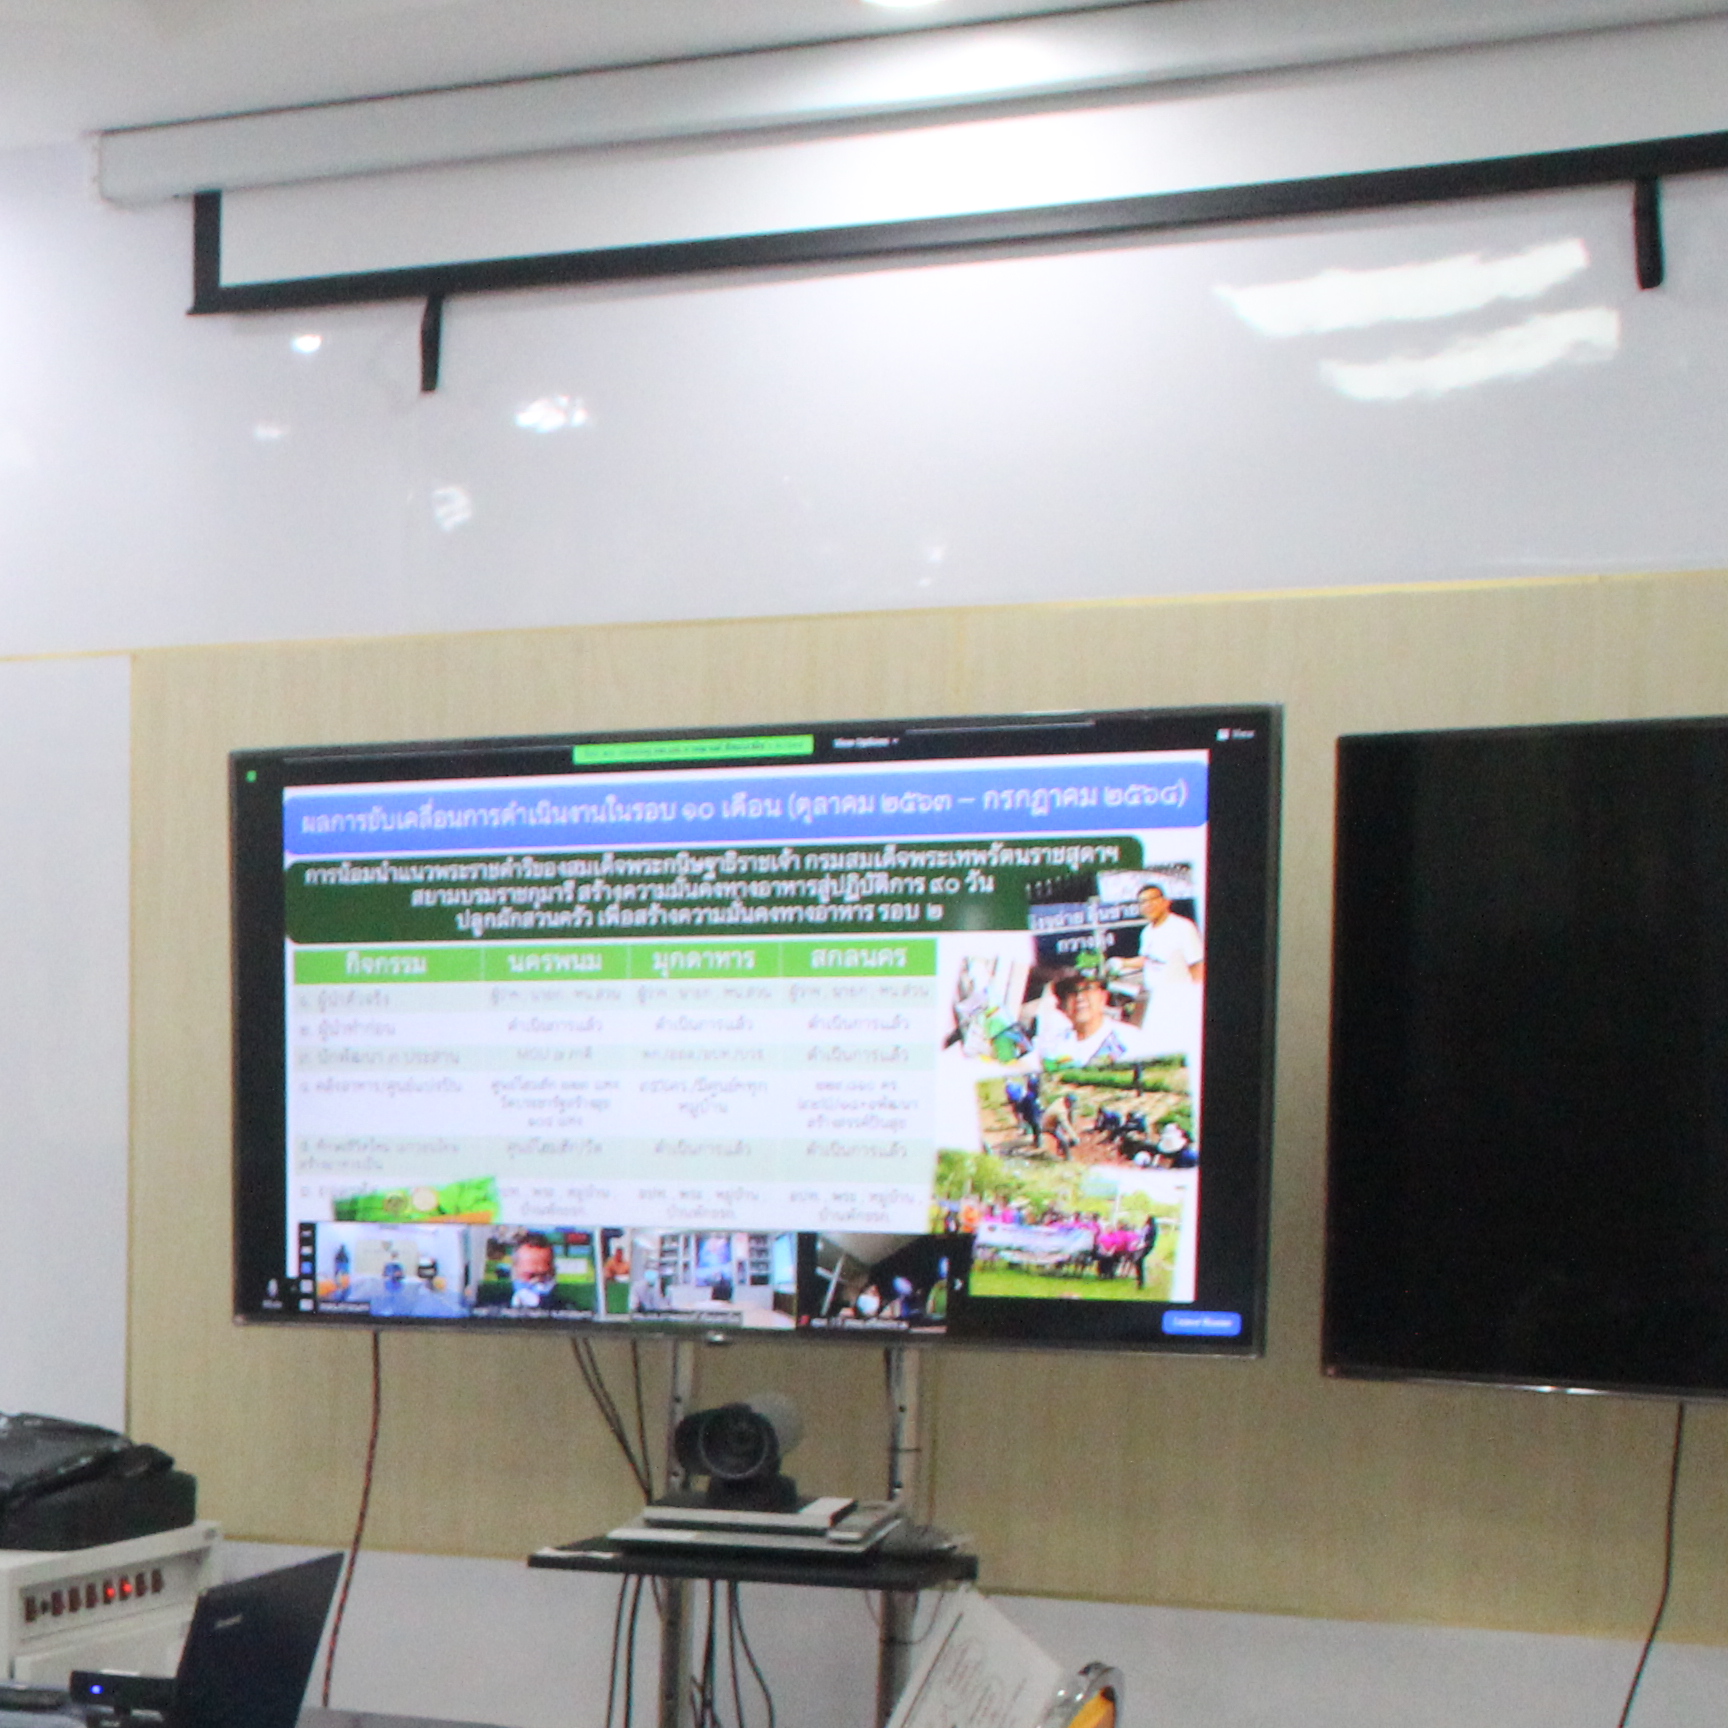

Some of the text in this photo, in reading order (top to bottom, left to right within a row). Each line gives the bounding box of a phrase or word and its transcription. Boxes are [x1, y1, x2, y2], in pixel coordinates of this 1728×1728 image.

[682, 802, 714, 821] ๑๐
[722, 791, 782, 818] เดือน
[788, 792, 875, 824] (ตุลาคม
[881, 791, 953, 813] ๒๕๖๓
[983, 786, 1097, 818] กรกฎาคม
[1104, 780, 1188, 808] ๒๕๖๔)
[411, 879, 576, 909] สยามบรมราชกุมารี
[965, 869, 995, 893] วัน
[455, 904, 594, 937] ปลูกผักสวนครัว
[878, 903, 920, 922] รอบ
[926, 903, 944, 922] ๒
[344, 950, 427, 976] กิจกรรม
[507, 952, 603, 973] นครพนม
[652, 948, 756, 979] มุกดาหาร
[811, 946, 906, 969] สกลนคร
